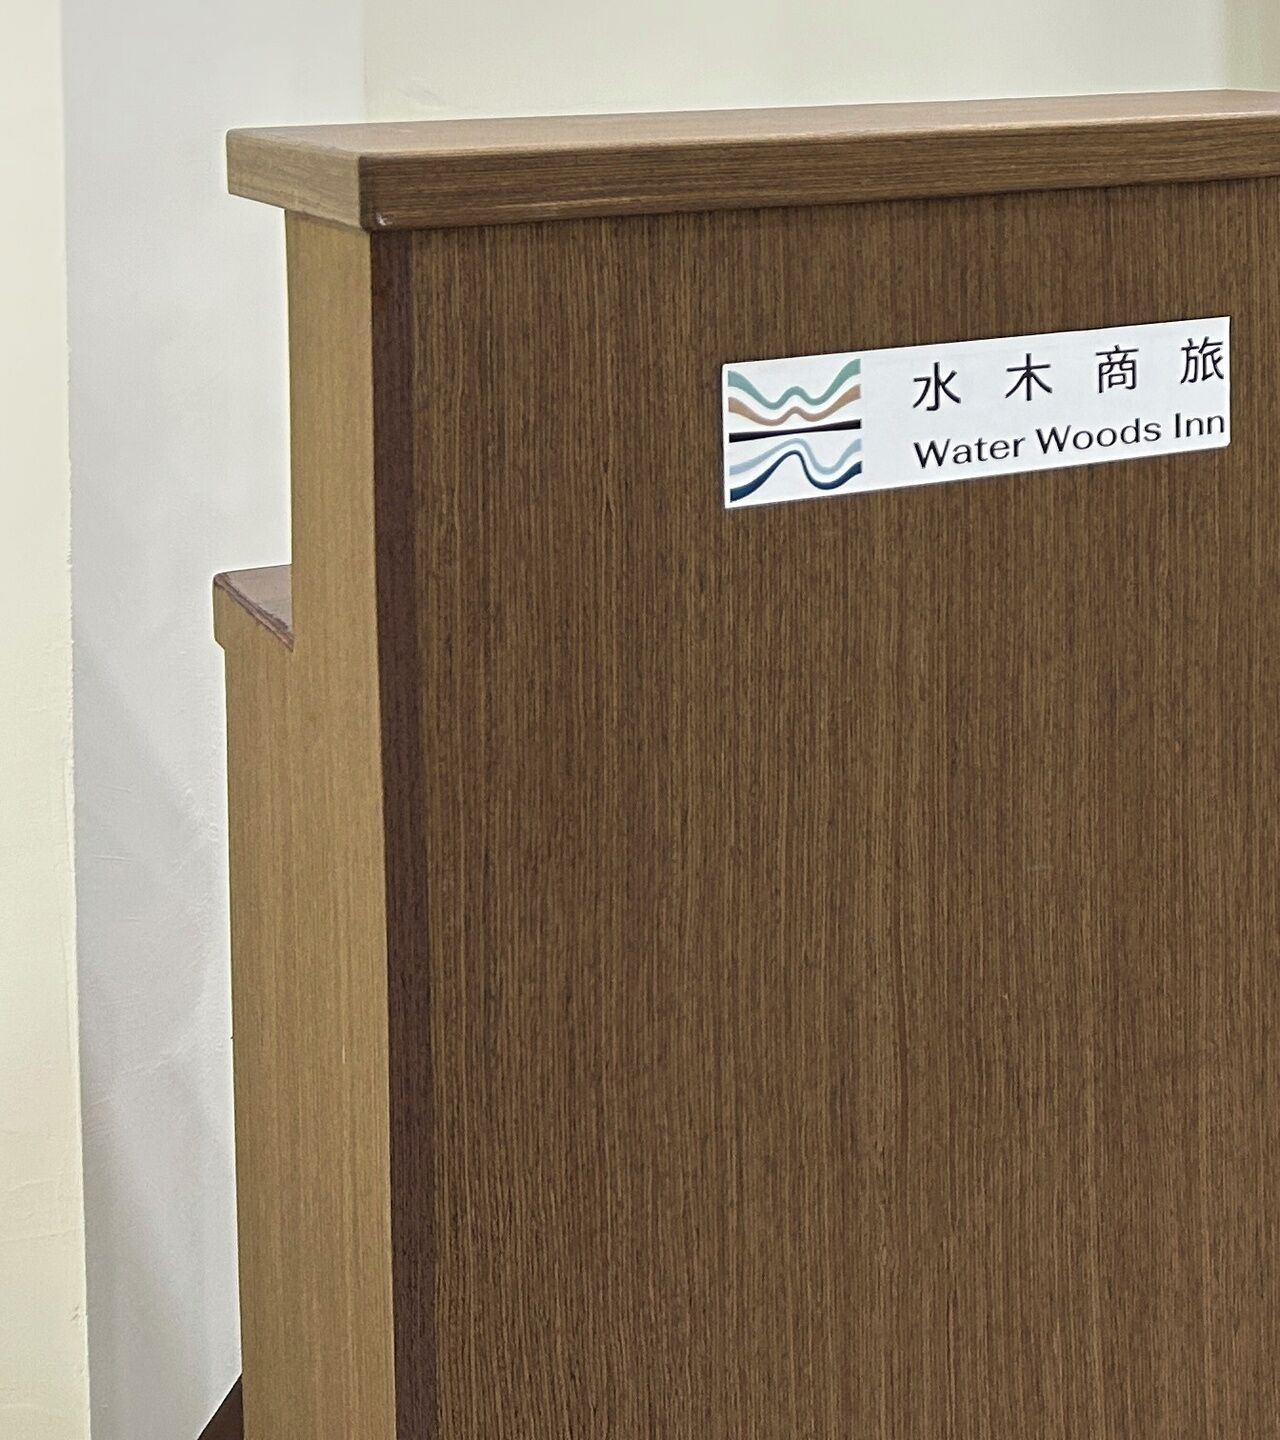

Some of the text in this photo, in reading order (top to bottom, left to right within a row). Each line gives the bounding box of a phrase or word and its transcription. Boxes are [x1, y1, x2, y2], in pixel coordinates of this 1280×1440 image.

[912, 336, 1225, 411] 水木商旅
[913, 412, 1225, 469] Water Woods Inn
